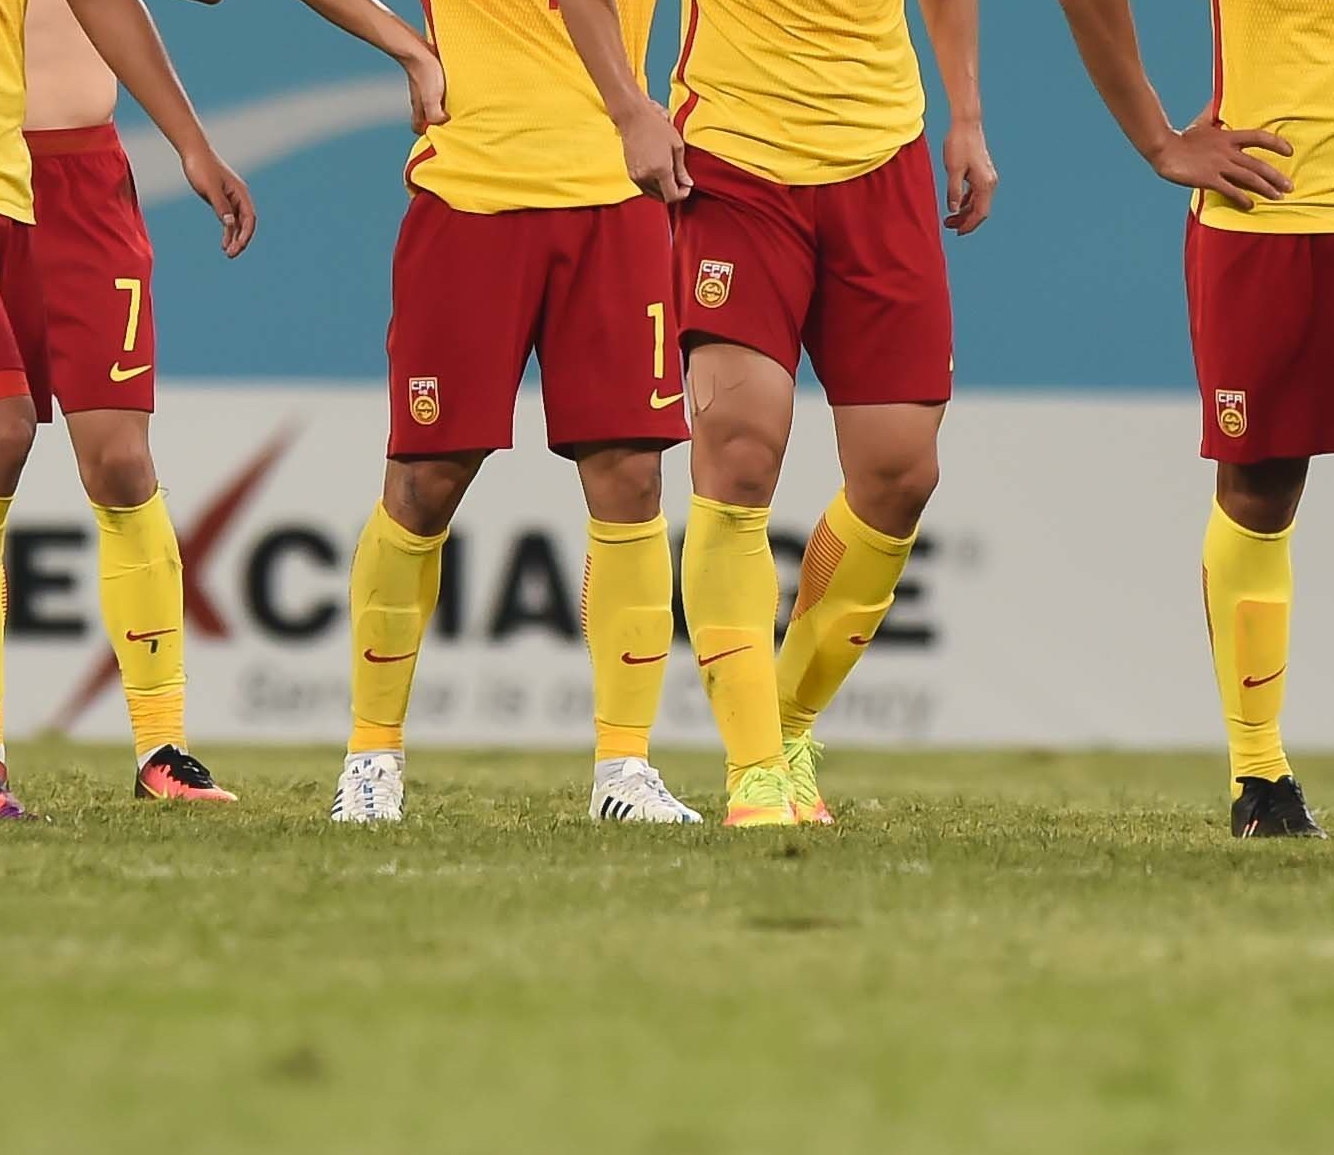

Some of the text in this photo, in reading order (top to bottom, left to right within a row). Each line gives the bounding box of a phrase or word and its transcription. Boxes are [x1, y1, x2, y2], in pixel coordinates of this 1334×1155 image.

[702, 263, 730, 275] CFA
[114, 278, 141, 352] 7
[647, 302, 664, 379] 1
[411, 380, 435, 390] CFA
[1218, 393, 1243, 403] CFA
